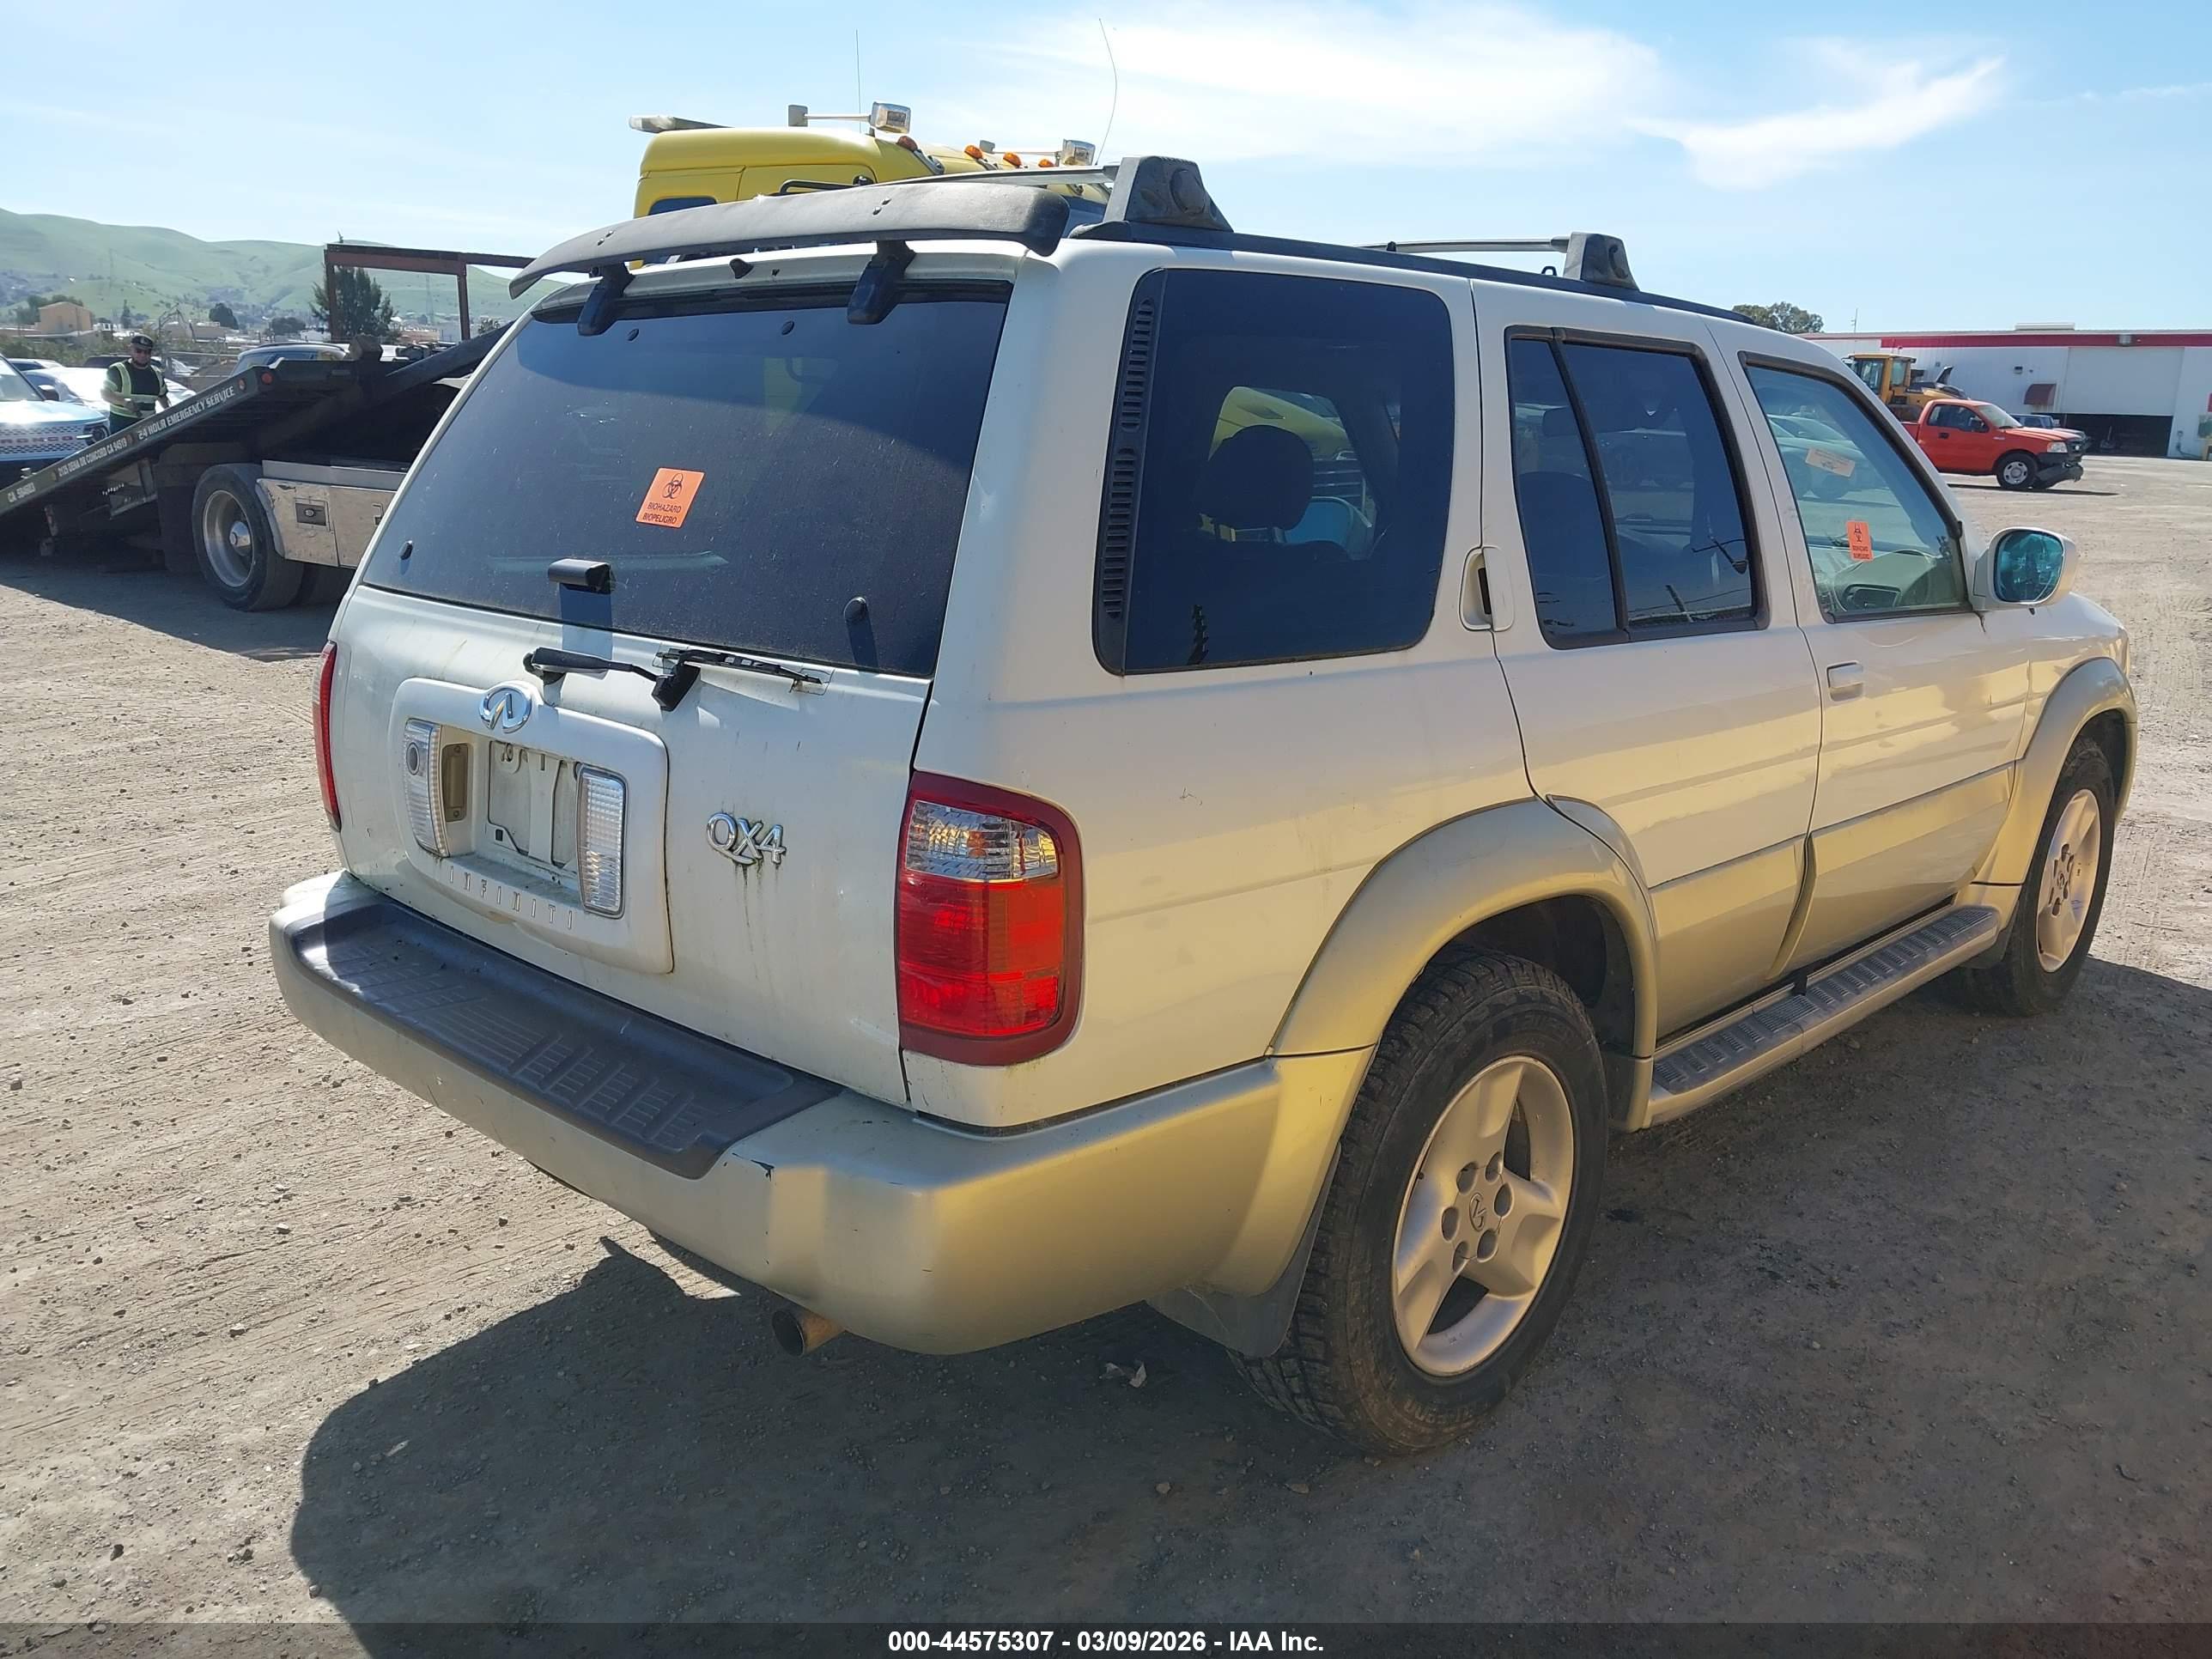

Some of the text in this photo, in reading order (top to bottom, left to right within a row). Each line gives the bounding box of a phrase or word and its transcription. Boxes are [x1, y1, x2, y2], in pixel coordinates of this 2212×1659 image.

[137, 386, 235, 440] 24 HOUR EMERGENCY SERVICE
[0, 435, 74, 444] RONCO
[642, 513, 678, 524] BIOPELIGRO
[647, 501, 682, 514] BIOHAZARD
[706, 811, 787, 865] QX4
[449, 865, 573, 930] INFINITI
